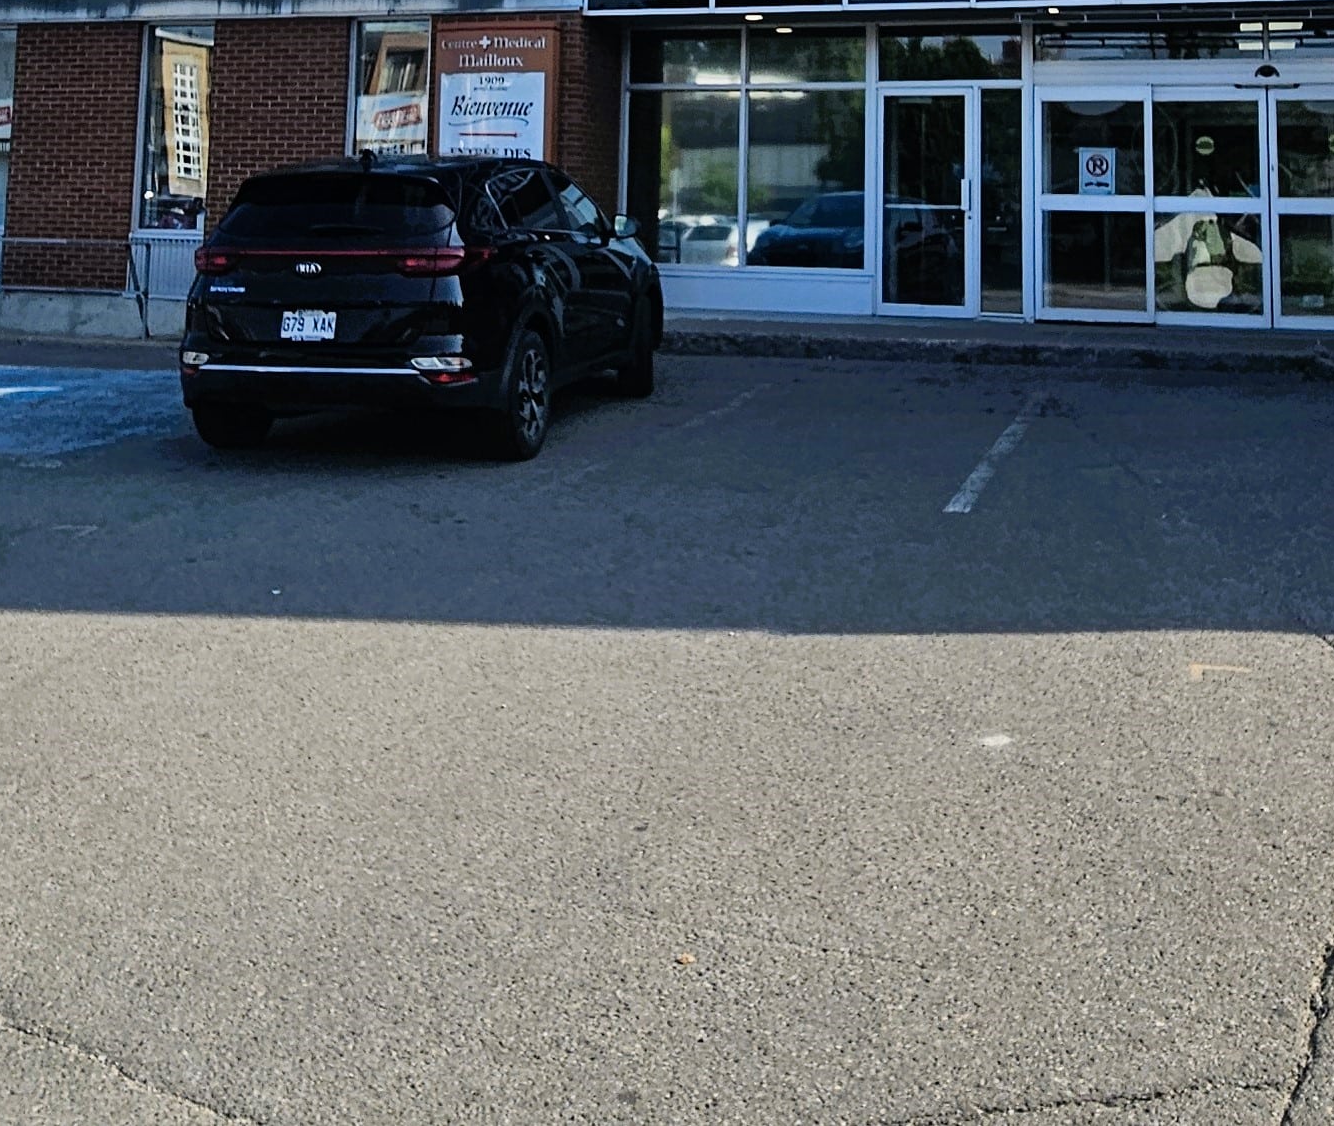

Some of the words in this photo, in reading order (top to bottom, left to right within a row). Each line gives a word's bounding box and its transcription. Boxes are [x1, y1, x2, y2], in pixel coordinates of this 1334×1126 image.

[441, 39, 477, 50] Centre
[459, 54, 524, 67] Mailloux
[451, 95, 534, 116] Bienvenue
[503, 148, 532, 160] DES
